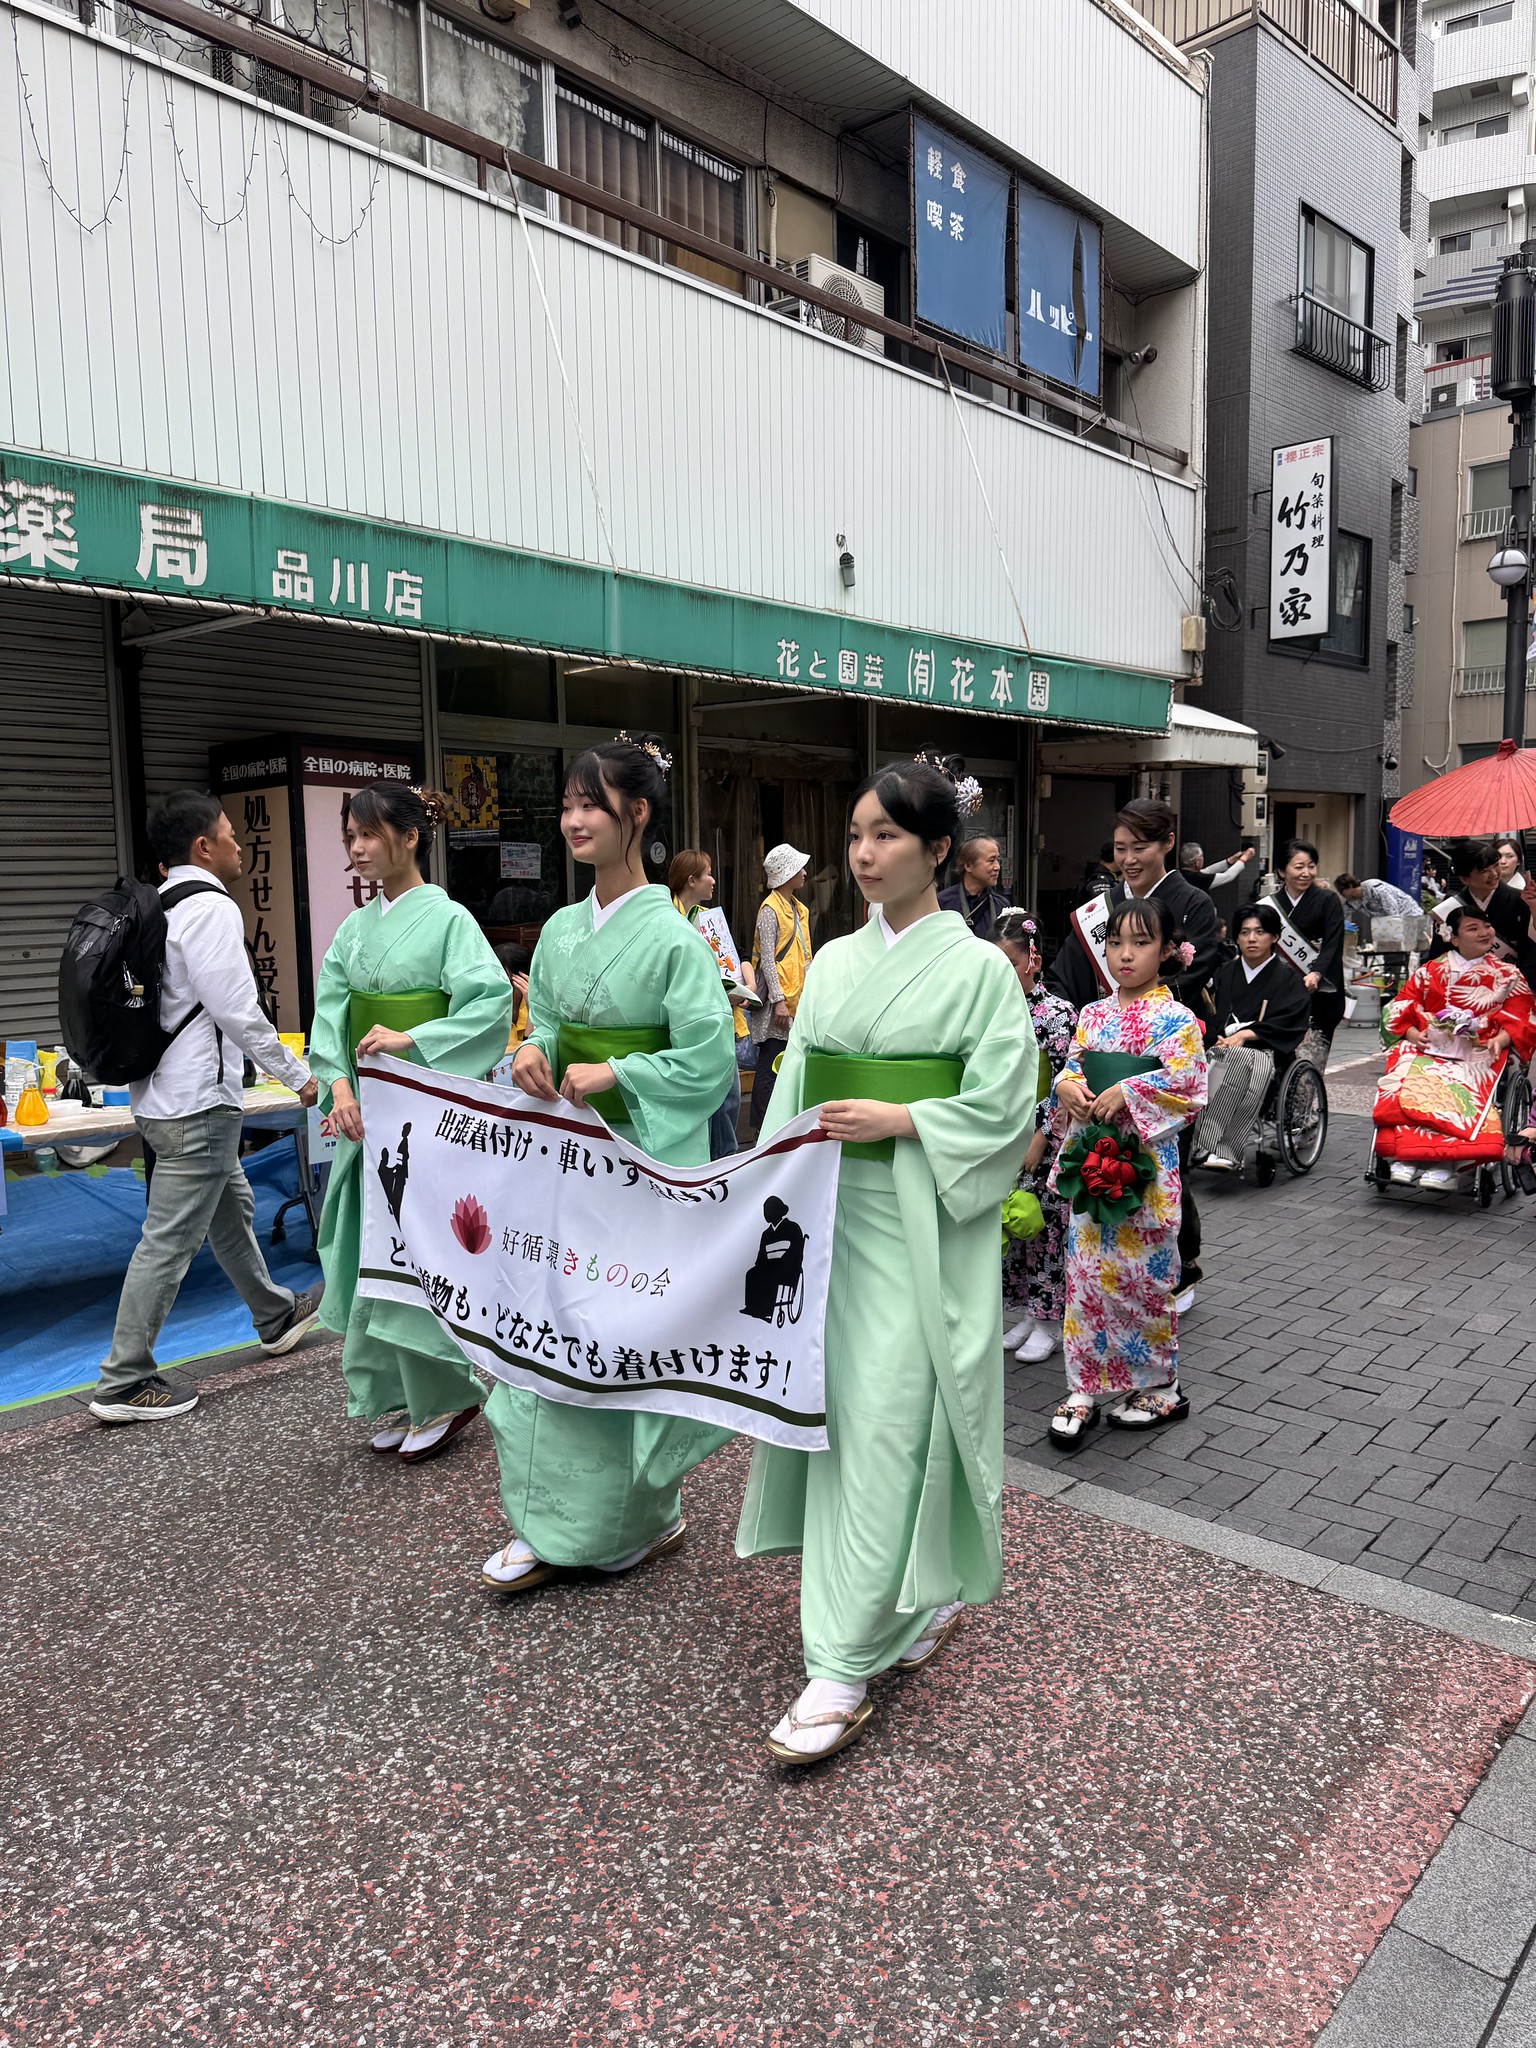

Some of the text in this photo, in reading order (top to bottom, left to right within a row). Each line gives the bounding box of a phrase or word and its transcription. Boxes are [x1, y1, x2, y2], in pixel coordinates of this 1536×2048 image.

[926, 146, 967, 194] 軽食
[926, 199, 965, 242] 喫茶
[1310, 472, 1325, 548] 旬菜料理
[0, 477, 424, 620] 薬局 品川店
[1277, 490, 1312, 627] 竹乃家
[775, 637, 884, 690] 花と園芸
[303, 756, 413, 780] 全国の病院・医院
[501, 1226, 673, 1298] 好循環きものの会
